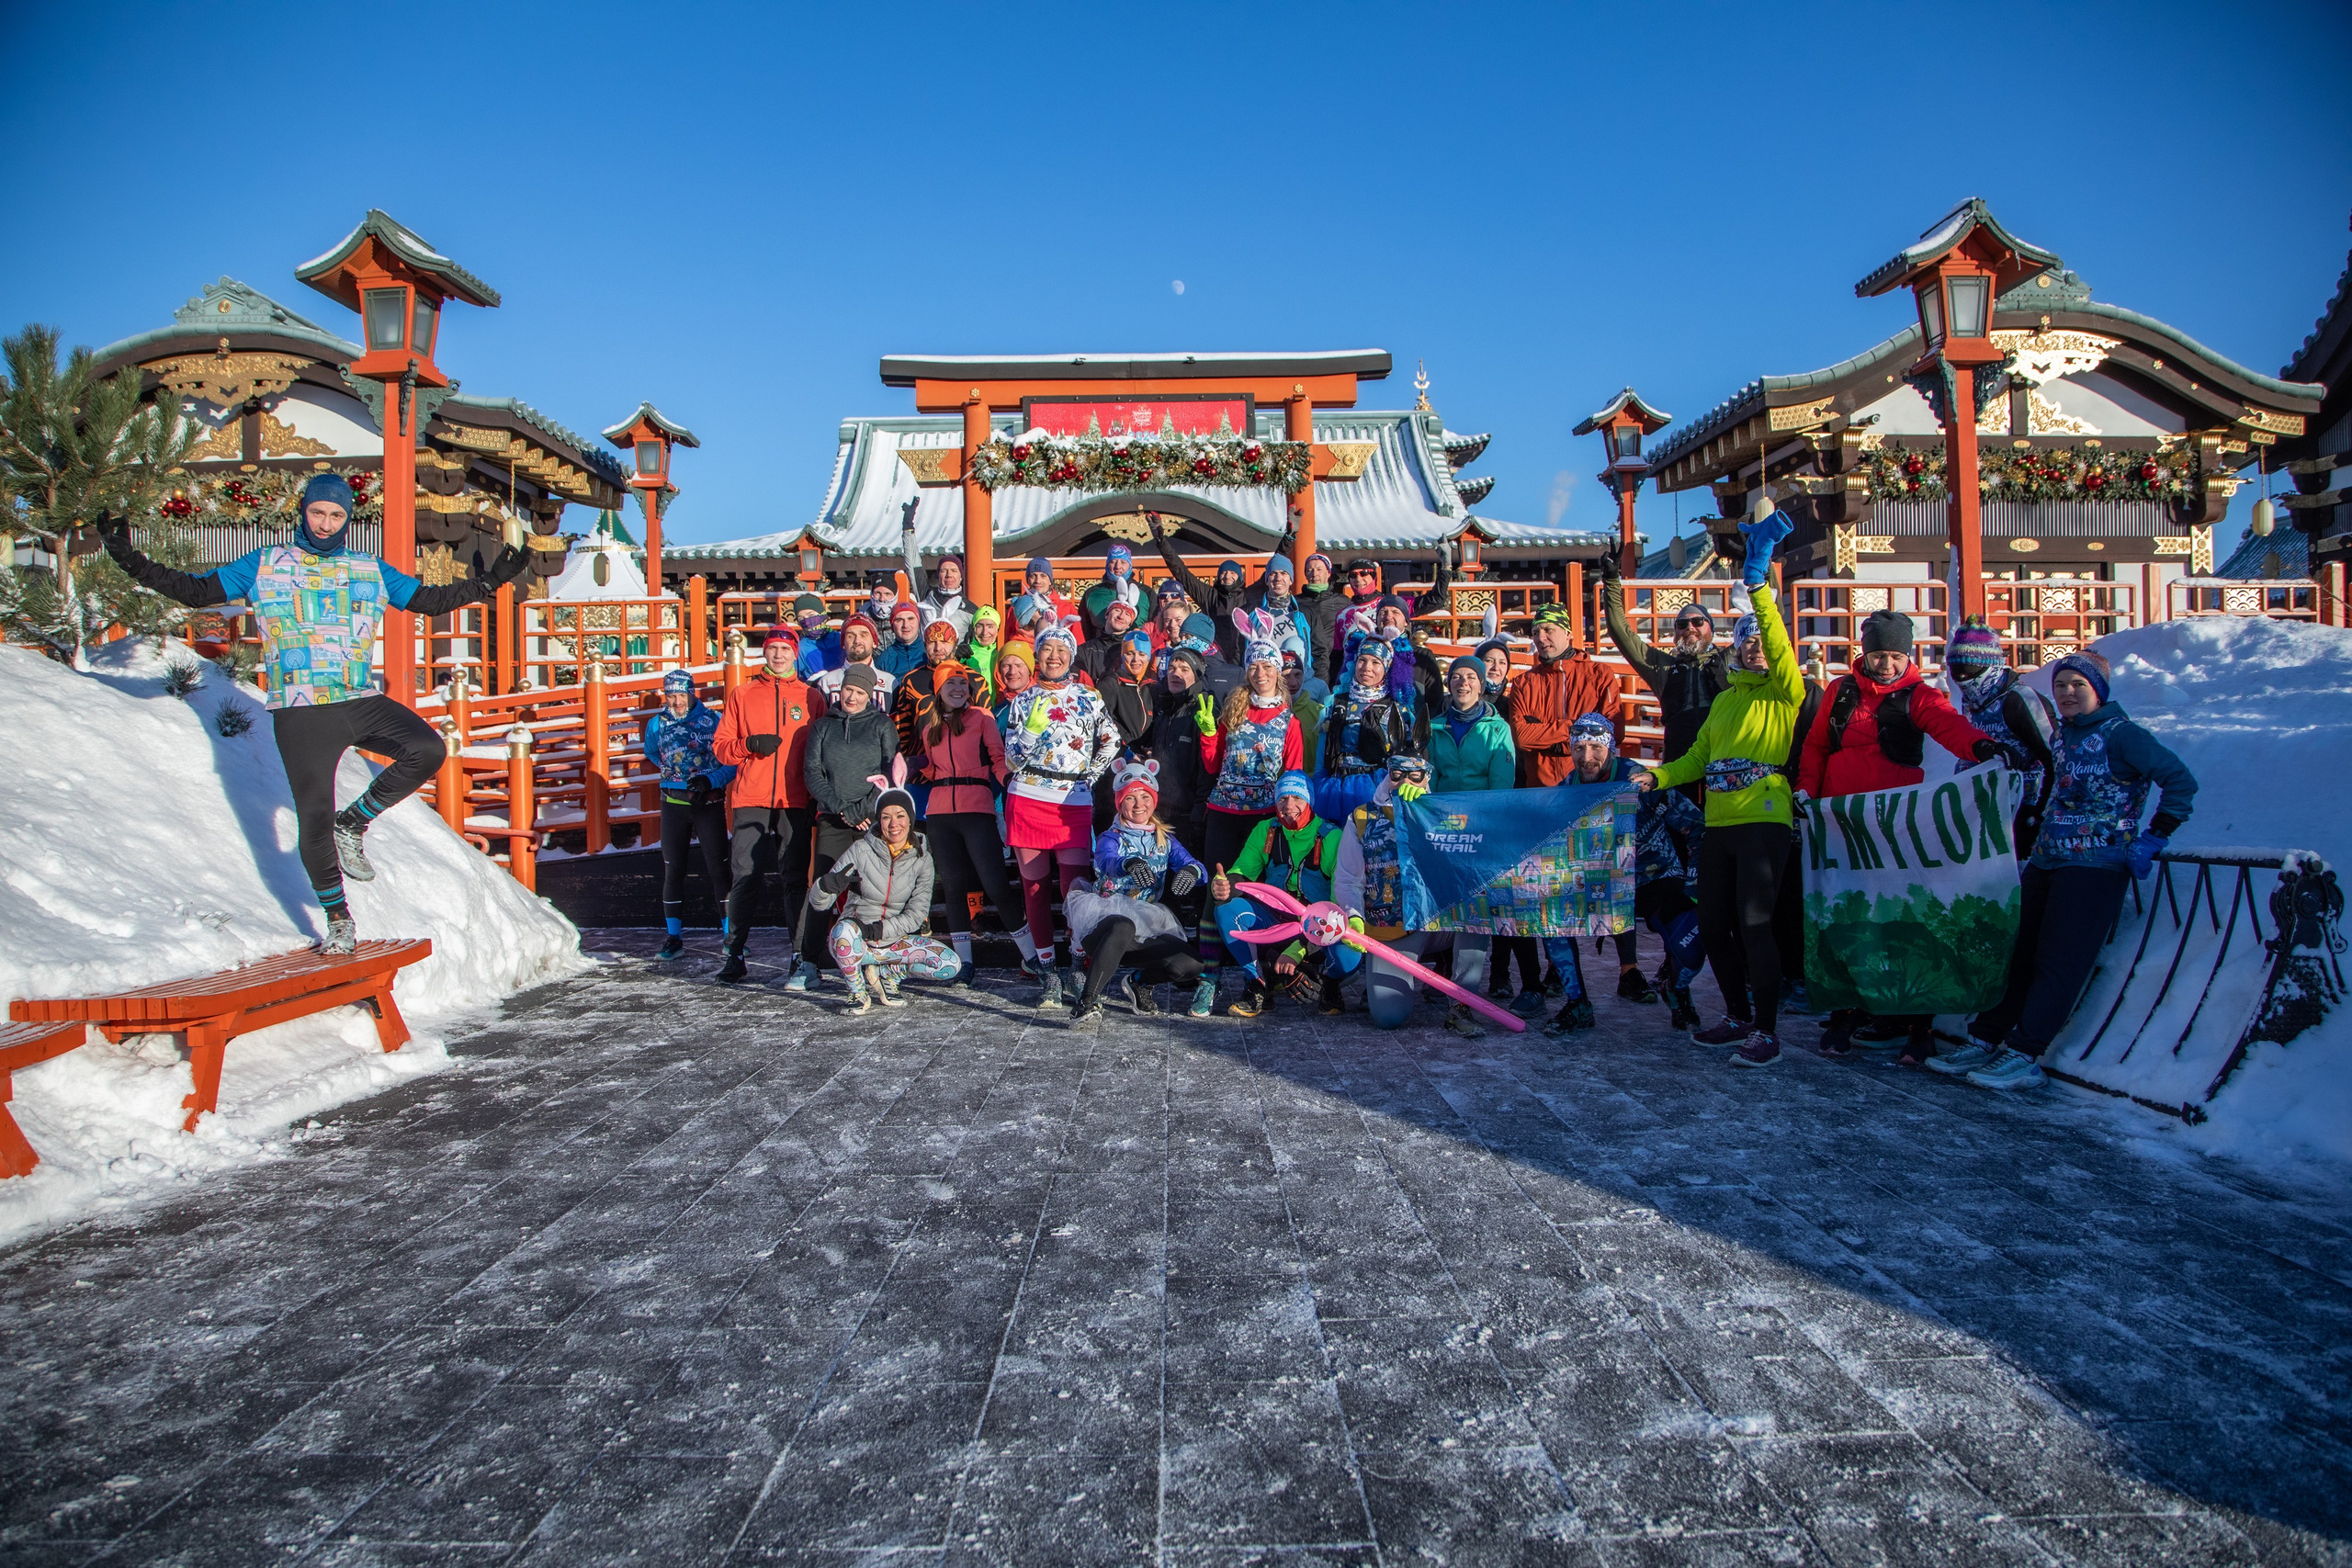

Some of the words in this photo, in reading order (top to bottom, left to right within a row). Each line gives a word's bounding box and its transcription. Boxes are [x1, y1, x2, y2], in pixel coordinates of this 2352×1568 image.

[1128, 430, 1158, 441] 2024
[1425, 831, 1484, 843] DREAM
[1431, 841, 1477, 852] TRAIL
